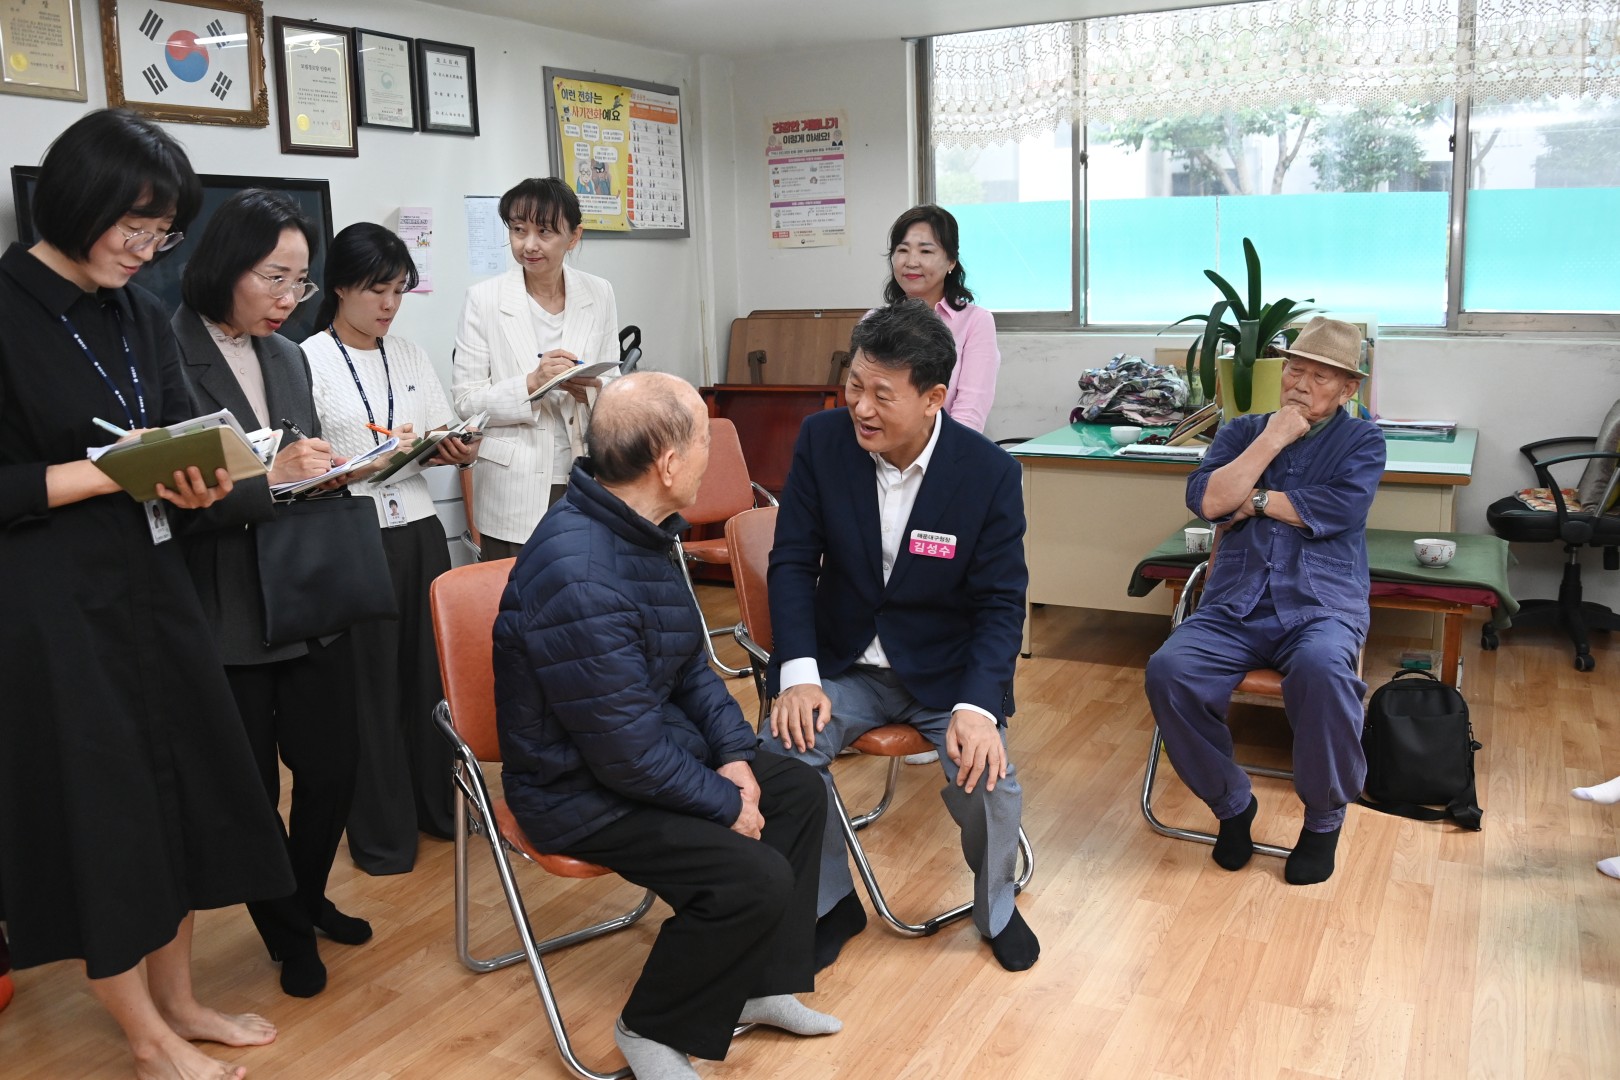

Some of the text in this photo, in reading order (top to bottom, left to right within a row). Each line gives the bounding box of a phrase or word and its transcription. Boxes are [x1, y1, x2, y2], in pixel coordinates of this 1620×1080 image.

[561, 88, 603, 105] 이런 전화는
[572, 105, 621, 121] 사기전화예요
[916, 532, 951, 543] 해운대구청장
[914, 541, 951, 557] 김성수
